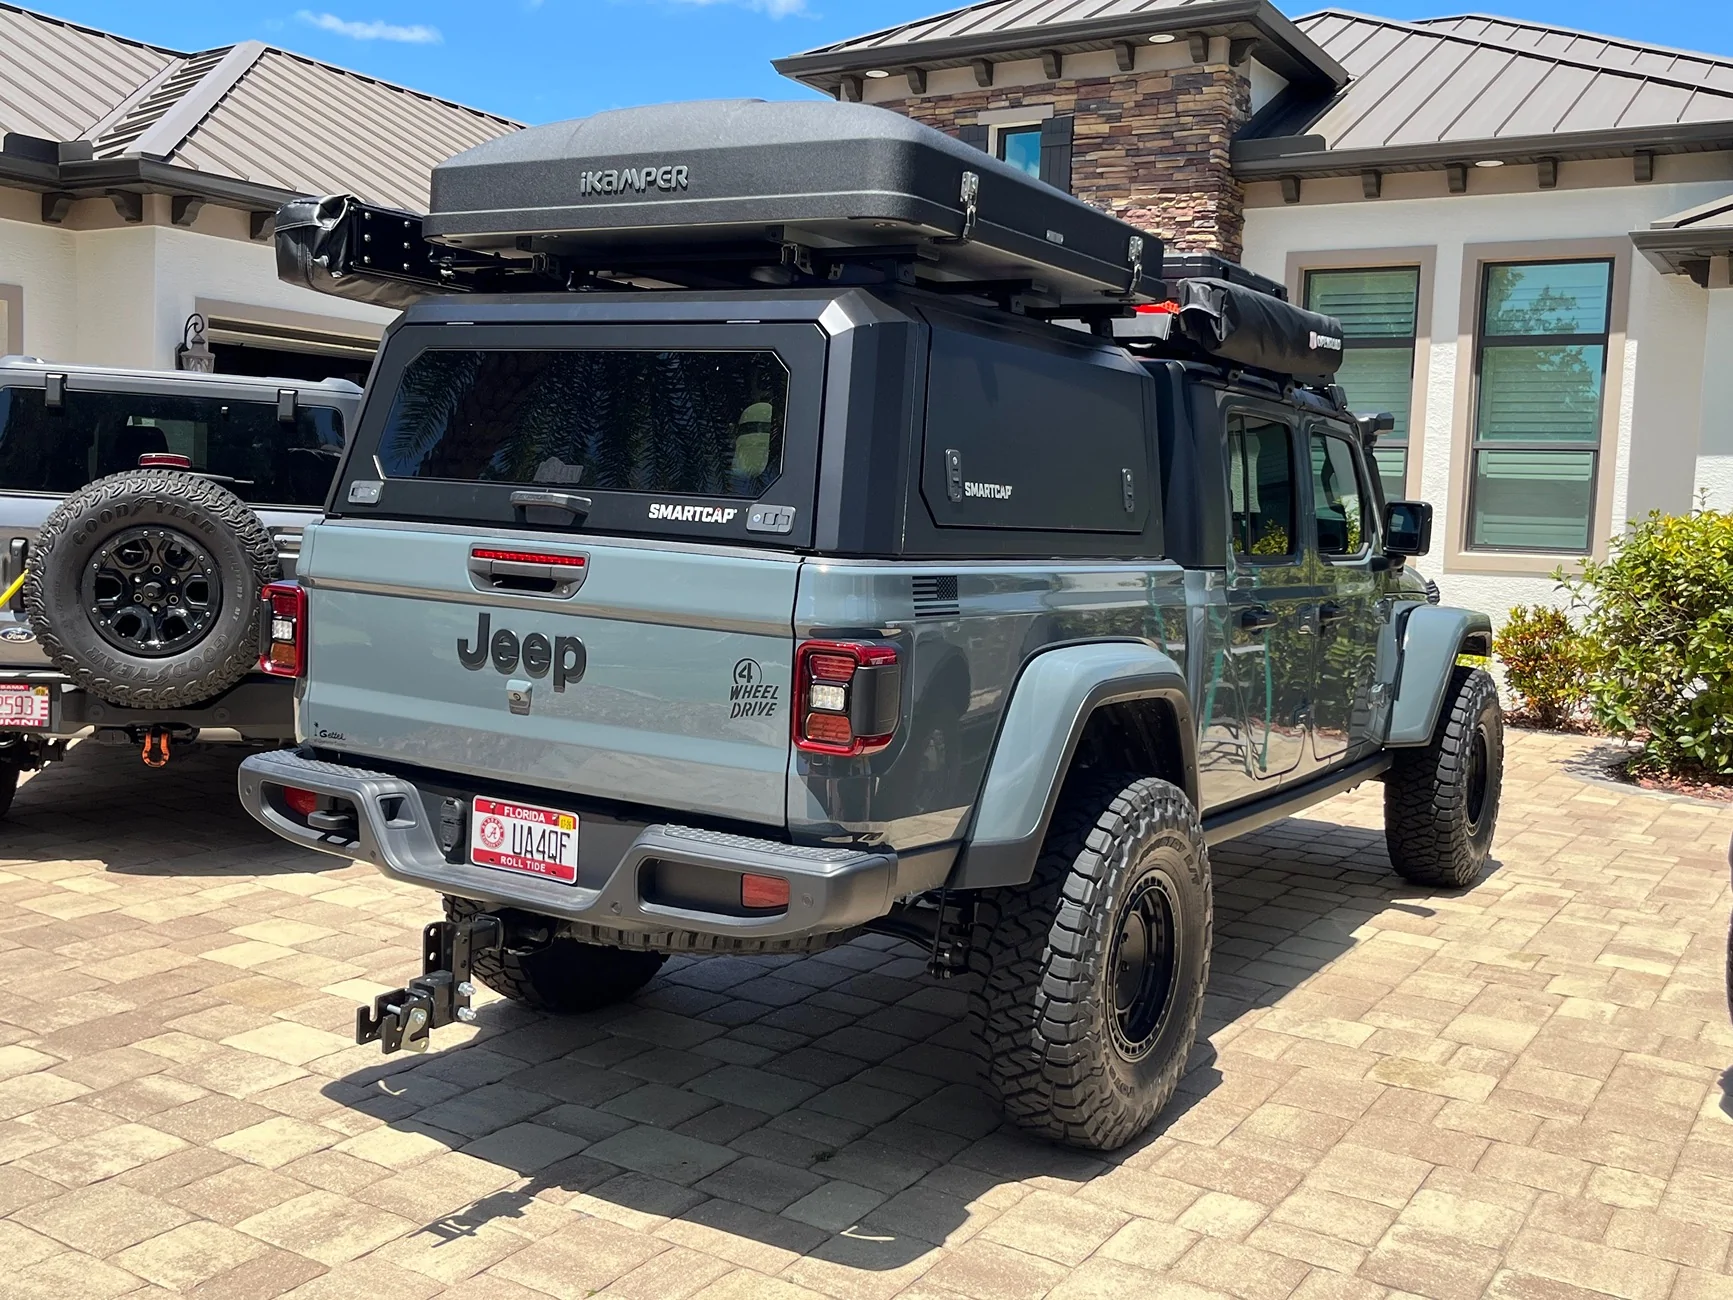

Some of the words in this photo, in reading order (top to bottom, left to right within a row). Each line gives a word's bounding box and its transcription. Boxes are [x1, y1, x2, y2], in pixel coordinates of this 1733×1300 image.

[964, 481, 1013, 500] SMARTCAP
[6, 632, 27, 640] Ford
[456, 612, 587, 693] Jeep
[738, 662, 753, 684] 4
[729, 684, 779, 702] WHEEL
[729, 701, 777, 719] DRIVE
[503, 806, 546, 823] FLORIDA
[512, 822, 571, 865] UA4QF
[500, 855, 523, 868] ROLL
[526, 860, 546, 872] TIDE
